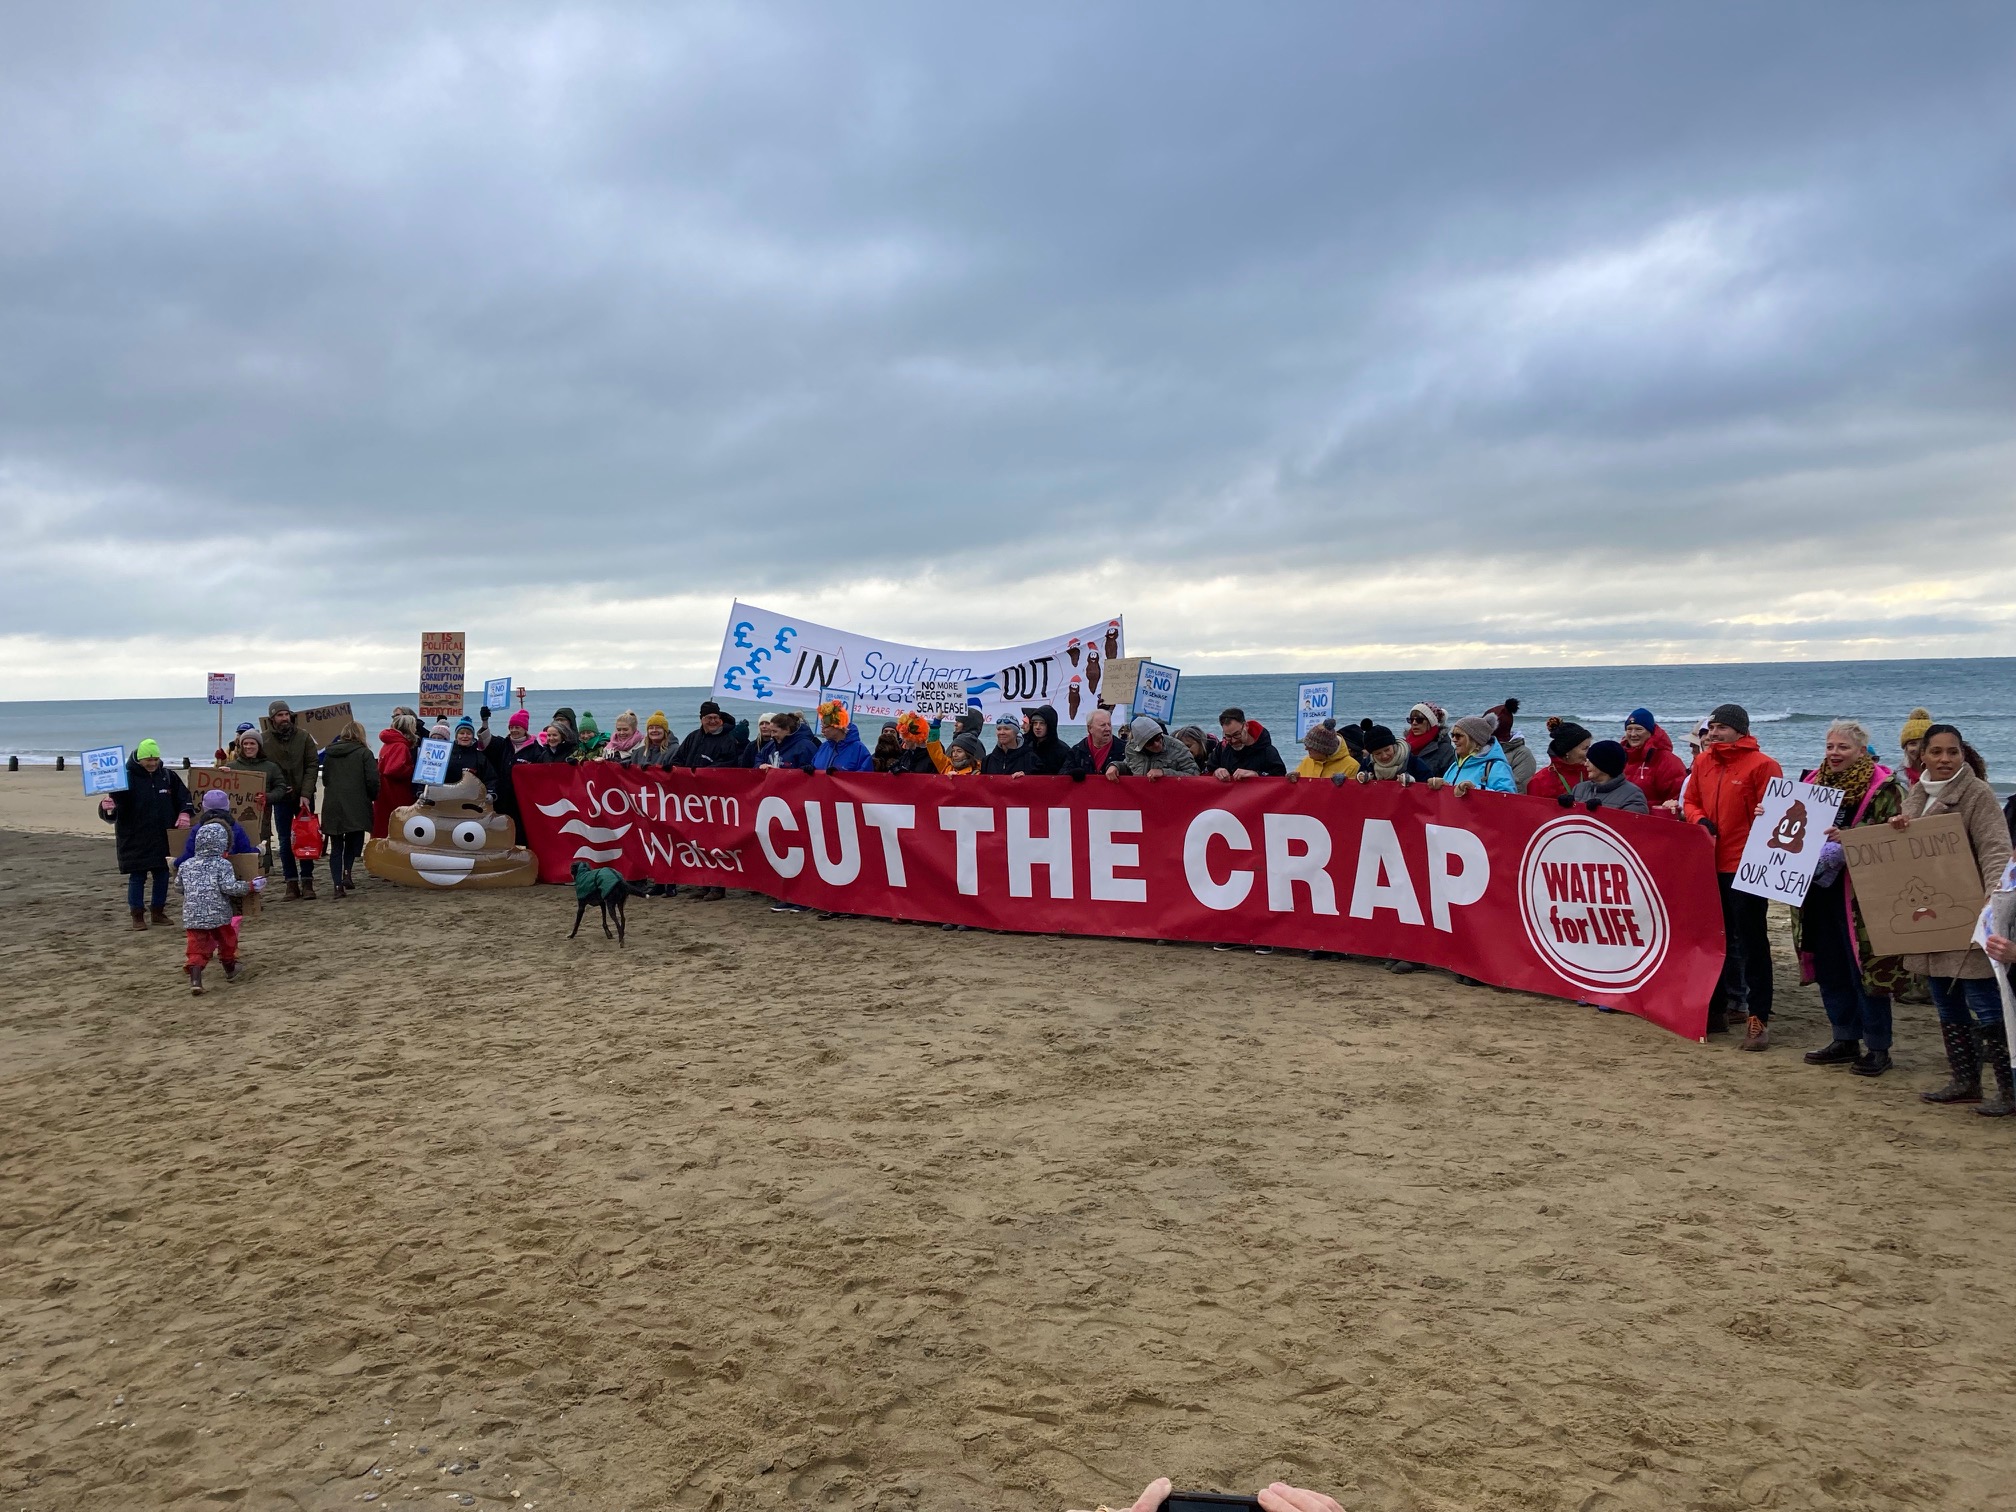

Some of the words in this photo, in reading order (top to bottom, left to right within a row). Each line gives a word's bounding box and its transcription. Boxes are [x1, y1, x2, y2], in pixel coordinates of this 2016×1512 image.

[442, 633, 452, 641] IS
[423, 642, 464, 650] POLITICAL
[423, 654, 463, 666] TORY
[790, 651, 839, 688] IN
[861, 651, 971, 685] Southern
[1107, 664, 1126, 673] START
[421, 673, 464, 681] CORRUPTION
[1002, 657, 1054, 700] OUT
[1154, 677, 1171, 691] NO
[922, 682, 936, 690] NO
[938, 682, 959, 691] MORE
[916, 691, 936, 701] FAECES
[1312, 694, 1328, 708] NO
[866, 705, 890, 716] YEARS
[917, 702, 934, 713] SEA
[936, 702, 967, 715] PLEASE!
[100, 756, 118, 767] NO
[431, 749, 445, 760] NO
[229, 792, 243, 805] My
[1767, 779, 1794, 798] NO
[1808, 787, 1844, 807] MORE
[586, 780, 740, 827] Southern
[638, 828, 744, 873] Water
[1845, 839, 1898, 868] DON'T
[1908, 831, 1960, 860] DUMP
[755, 796, 915, 888] CUT
[938, 805, 1148, 904] THE
[1183, 808, 1491, 934] CRAP
[1769, 851, 1787, 866] IN
[1541, 862, 1632, 905] WATER
[1740, 863, 1769, 888] OUR
[1774, 870, 1812, 897] SEA!
